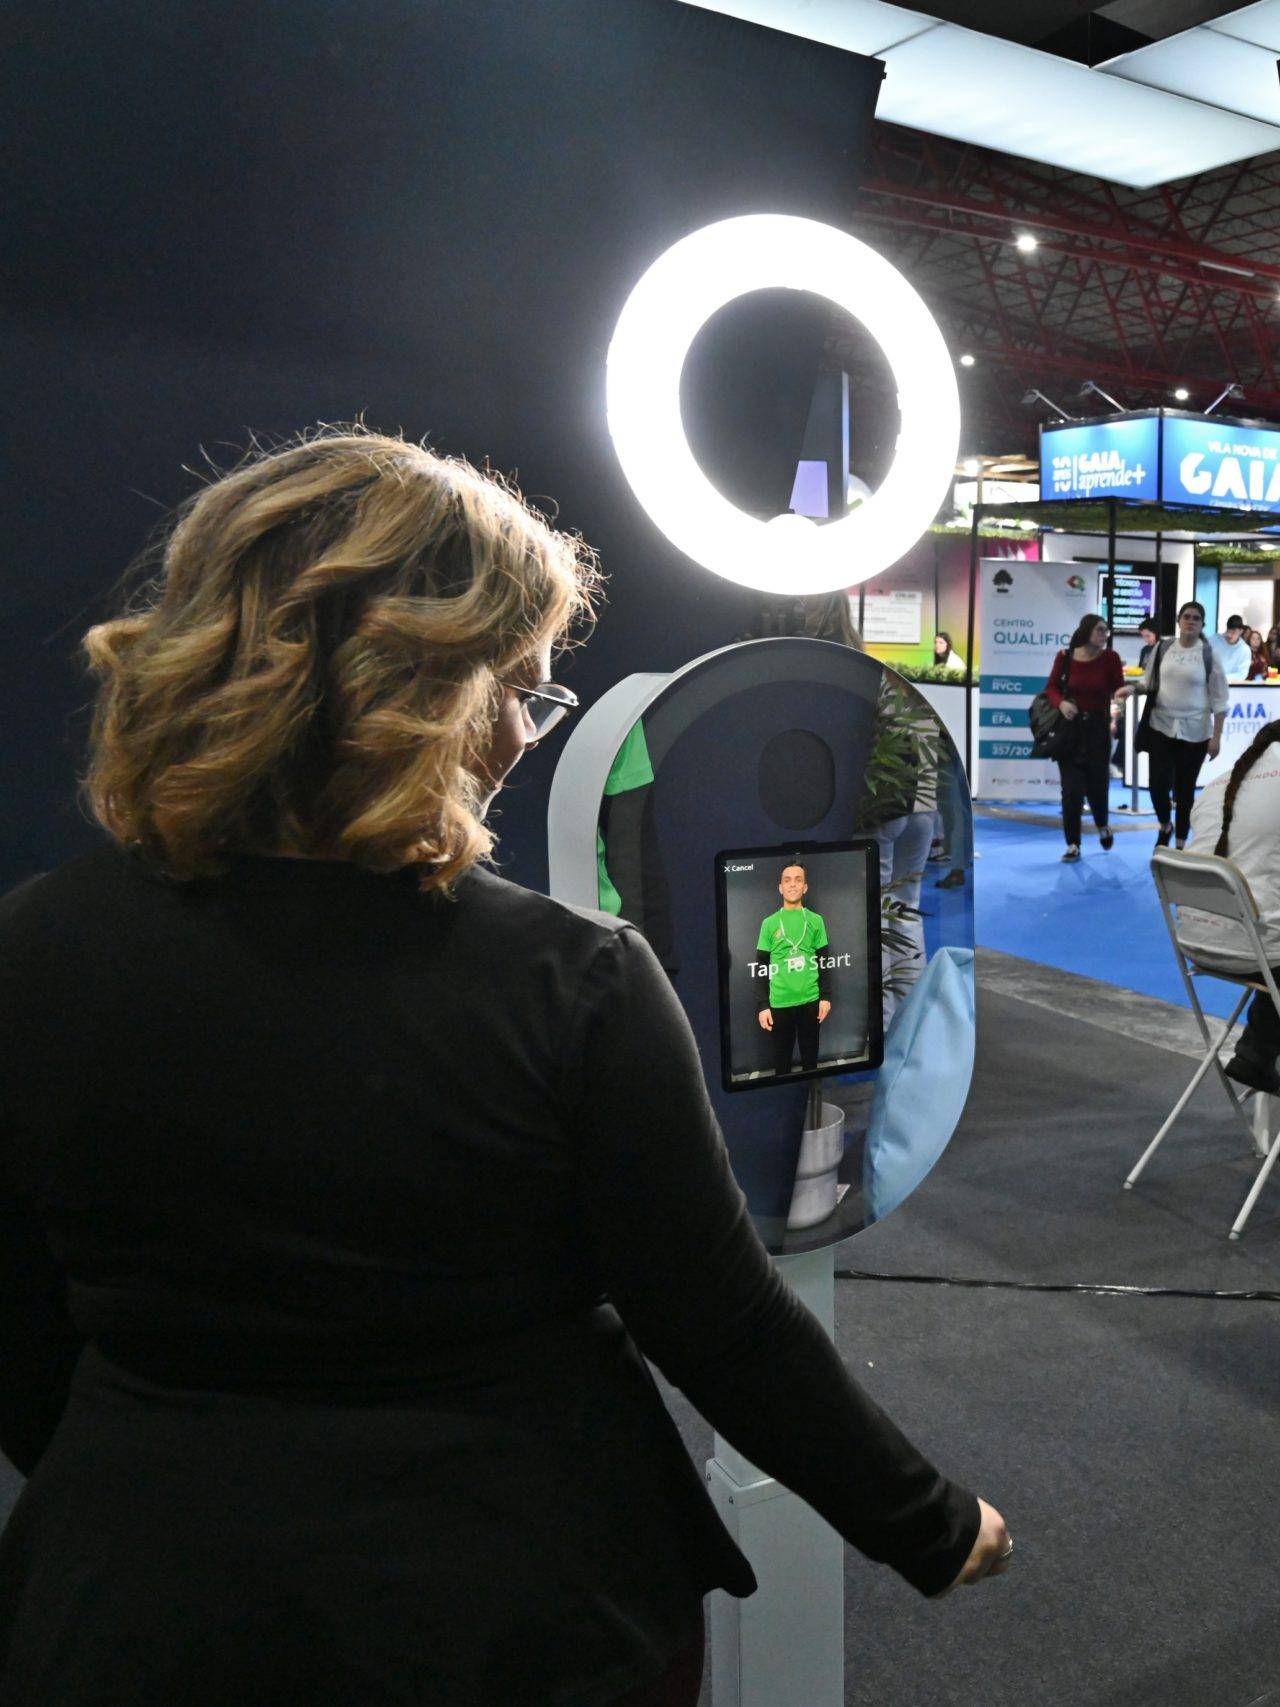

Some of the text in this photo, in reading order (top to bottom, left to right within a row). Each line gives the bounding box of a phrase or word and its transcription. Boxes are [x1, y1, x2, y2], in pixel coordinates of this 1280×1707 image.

[1079, 450, 1121, 473] GAIA
[993, 619, 1034, 628] CENTRO
[994, 631, 1071, 646] QUALIFIC
[1225, 703, 1266, 718] AIA
[992, 714, 1012, 725] EFA
[731, 864, 754, 873] Cancel
[748, 952, 851, 979] Tap To Start
